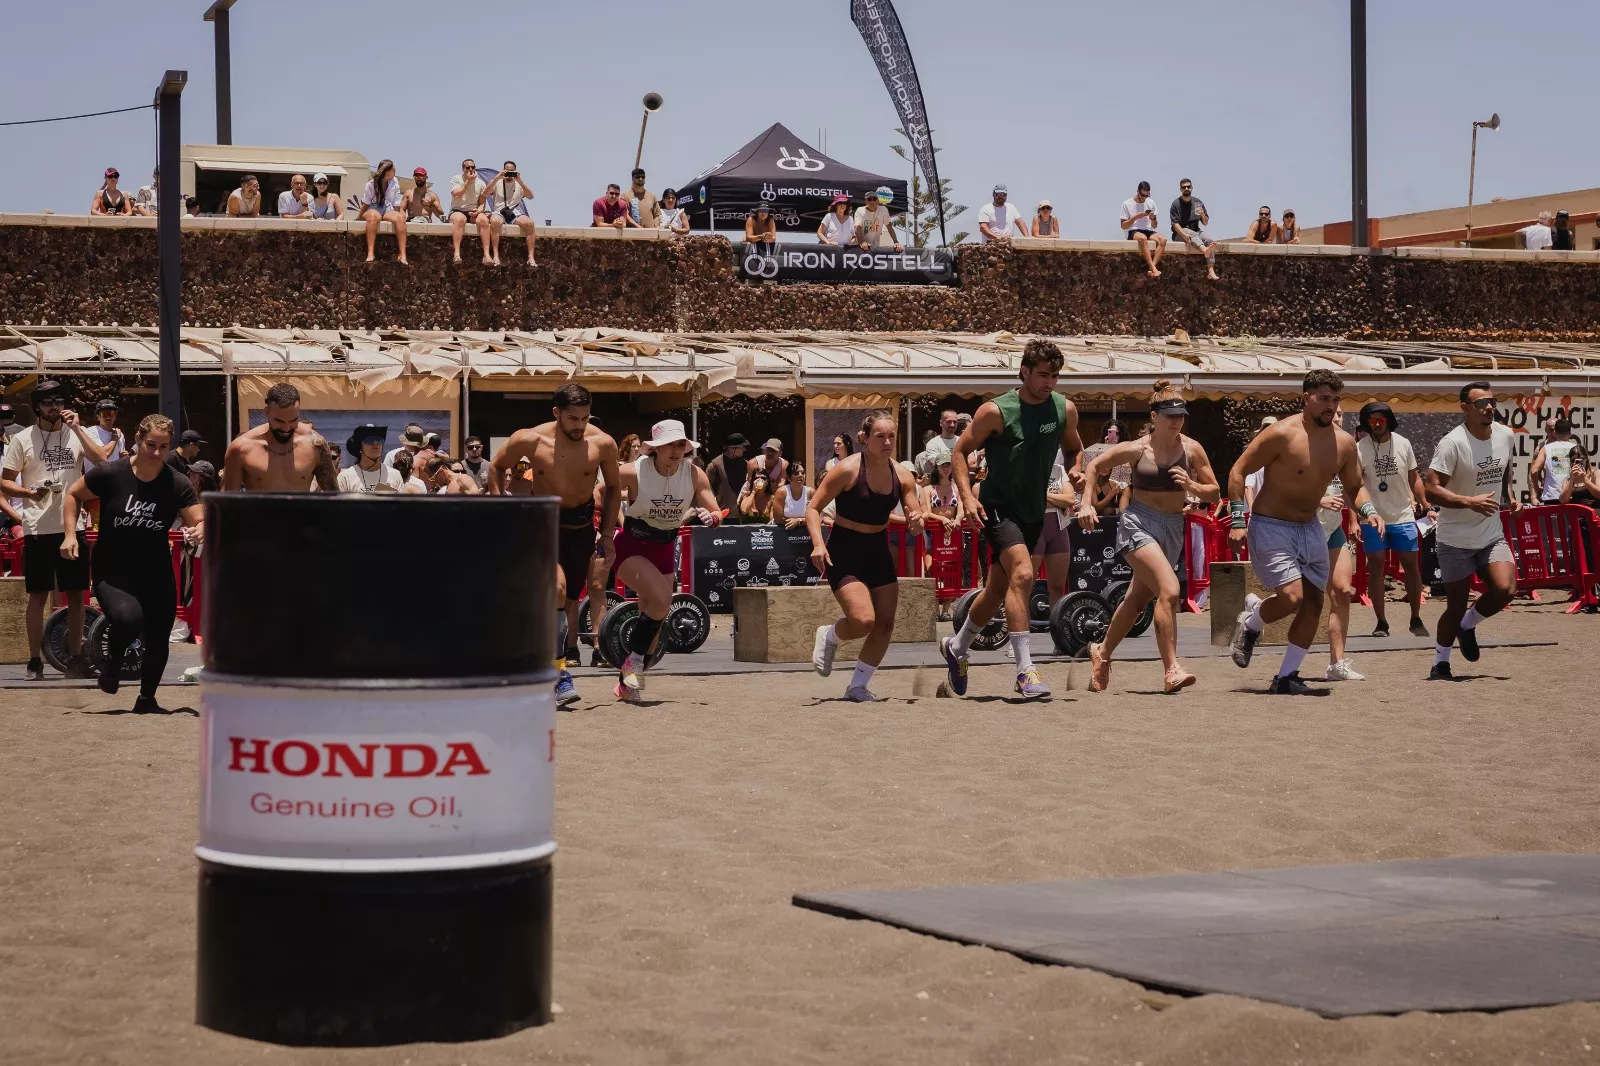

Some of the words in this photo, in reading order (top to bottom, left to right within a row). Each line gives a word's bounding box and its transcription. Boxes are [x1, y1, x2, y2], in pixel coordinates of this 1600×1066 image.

[777, 188, 801, 197] IRON
[805, 187, 854, 198] ROSTELL
[783, 251, 836, 269] IRON
[842, 253, 944, 270] ROSTELL
[113, 515, 165, 531] perros
[227, 736, 491, 779] HONDA
[250, 792, 396, 819] Genuine
[408, 796, 455, 819] Oil
